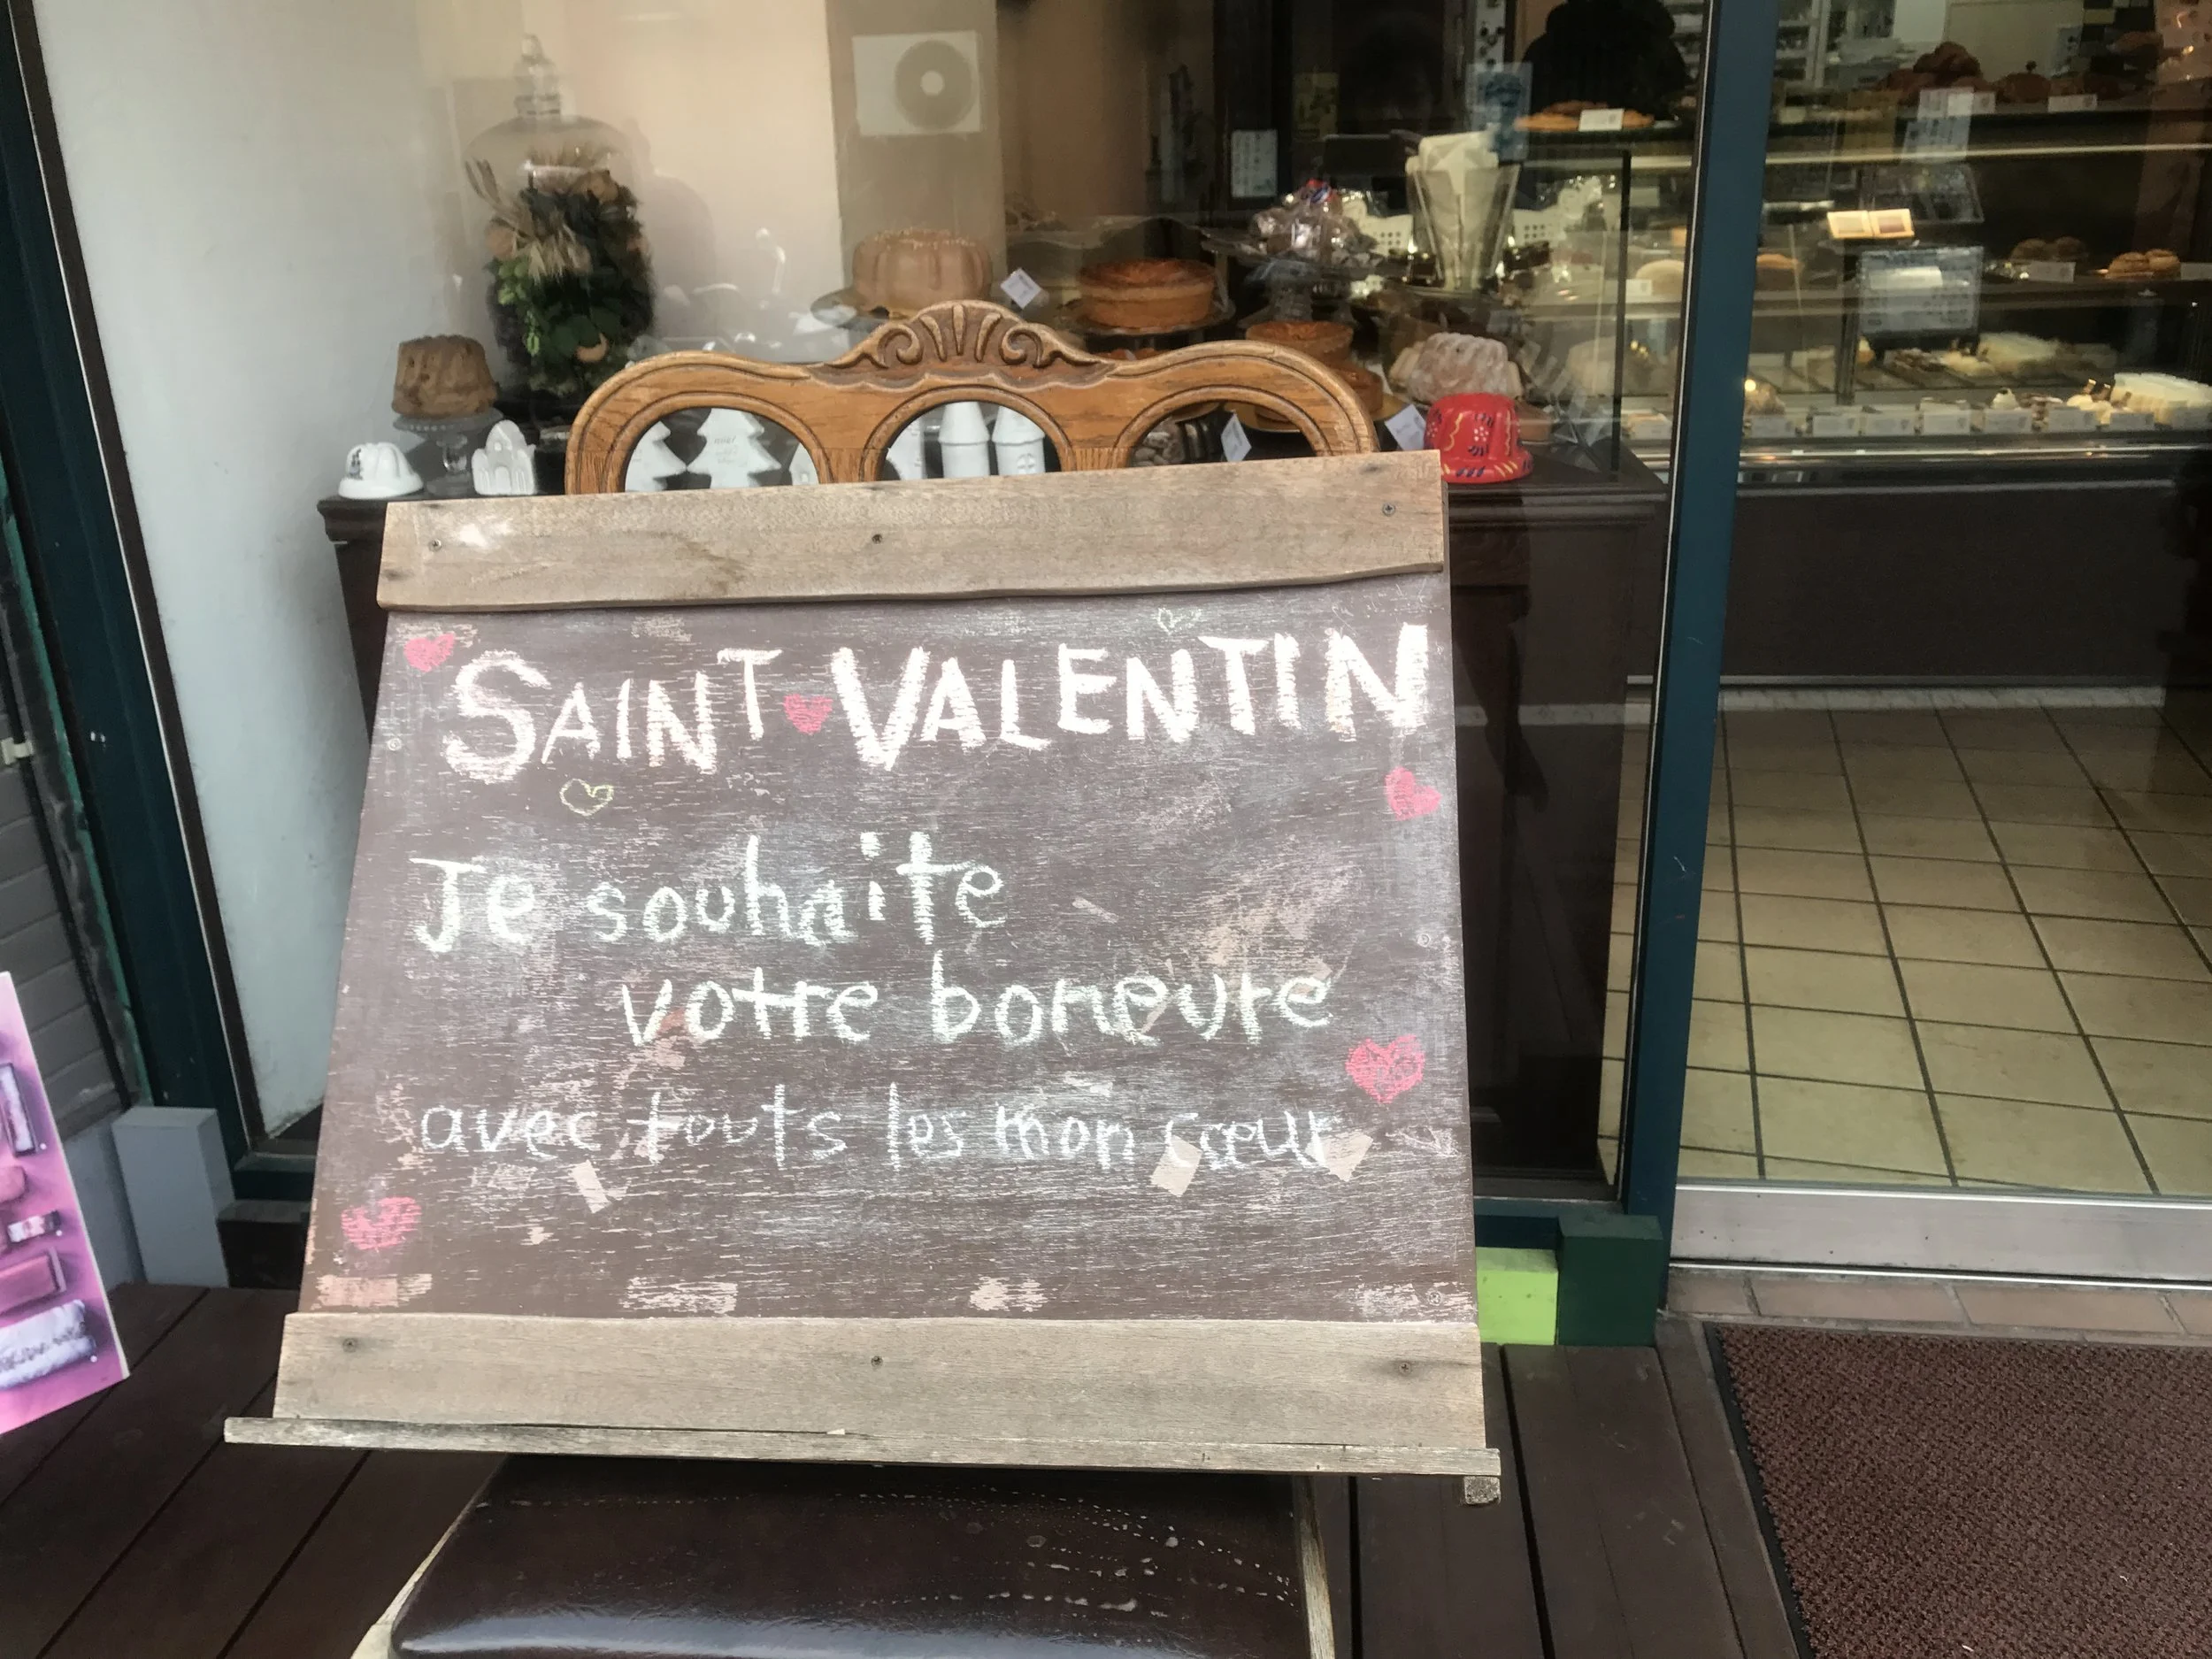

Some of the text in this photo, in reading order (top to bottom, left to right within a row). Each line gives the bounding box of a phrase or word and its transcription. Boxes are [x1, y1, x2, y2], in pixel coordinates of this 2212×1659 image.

[443, 622, 1430, 786] SAINT VALENTIN
[408, 833, 1007, 953] Je souhaite
[622, 949, 1333, 1047] votre boneure
[419, 1105, 601, 1161] avec
[627, 1082, 847, 1170] touts
[887, 1082, 966, 1172] les
[995, 1101, 1136, 1170] mon
